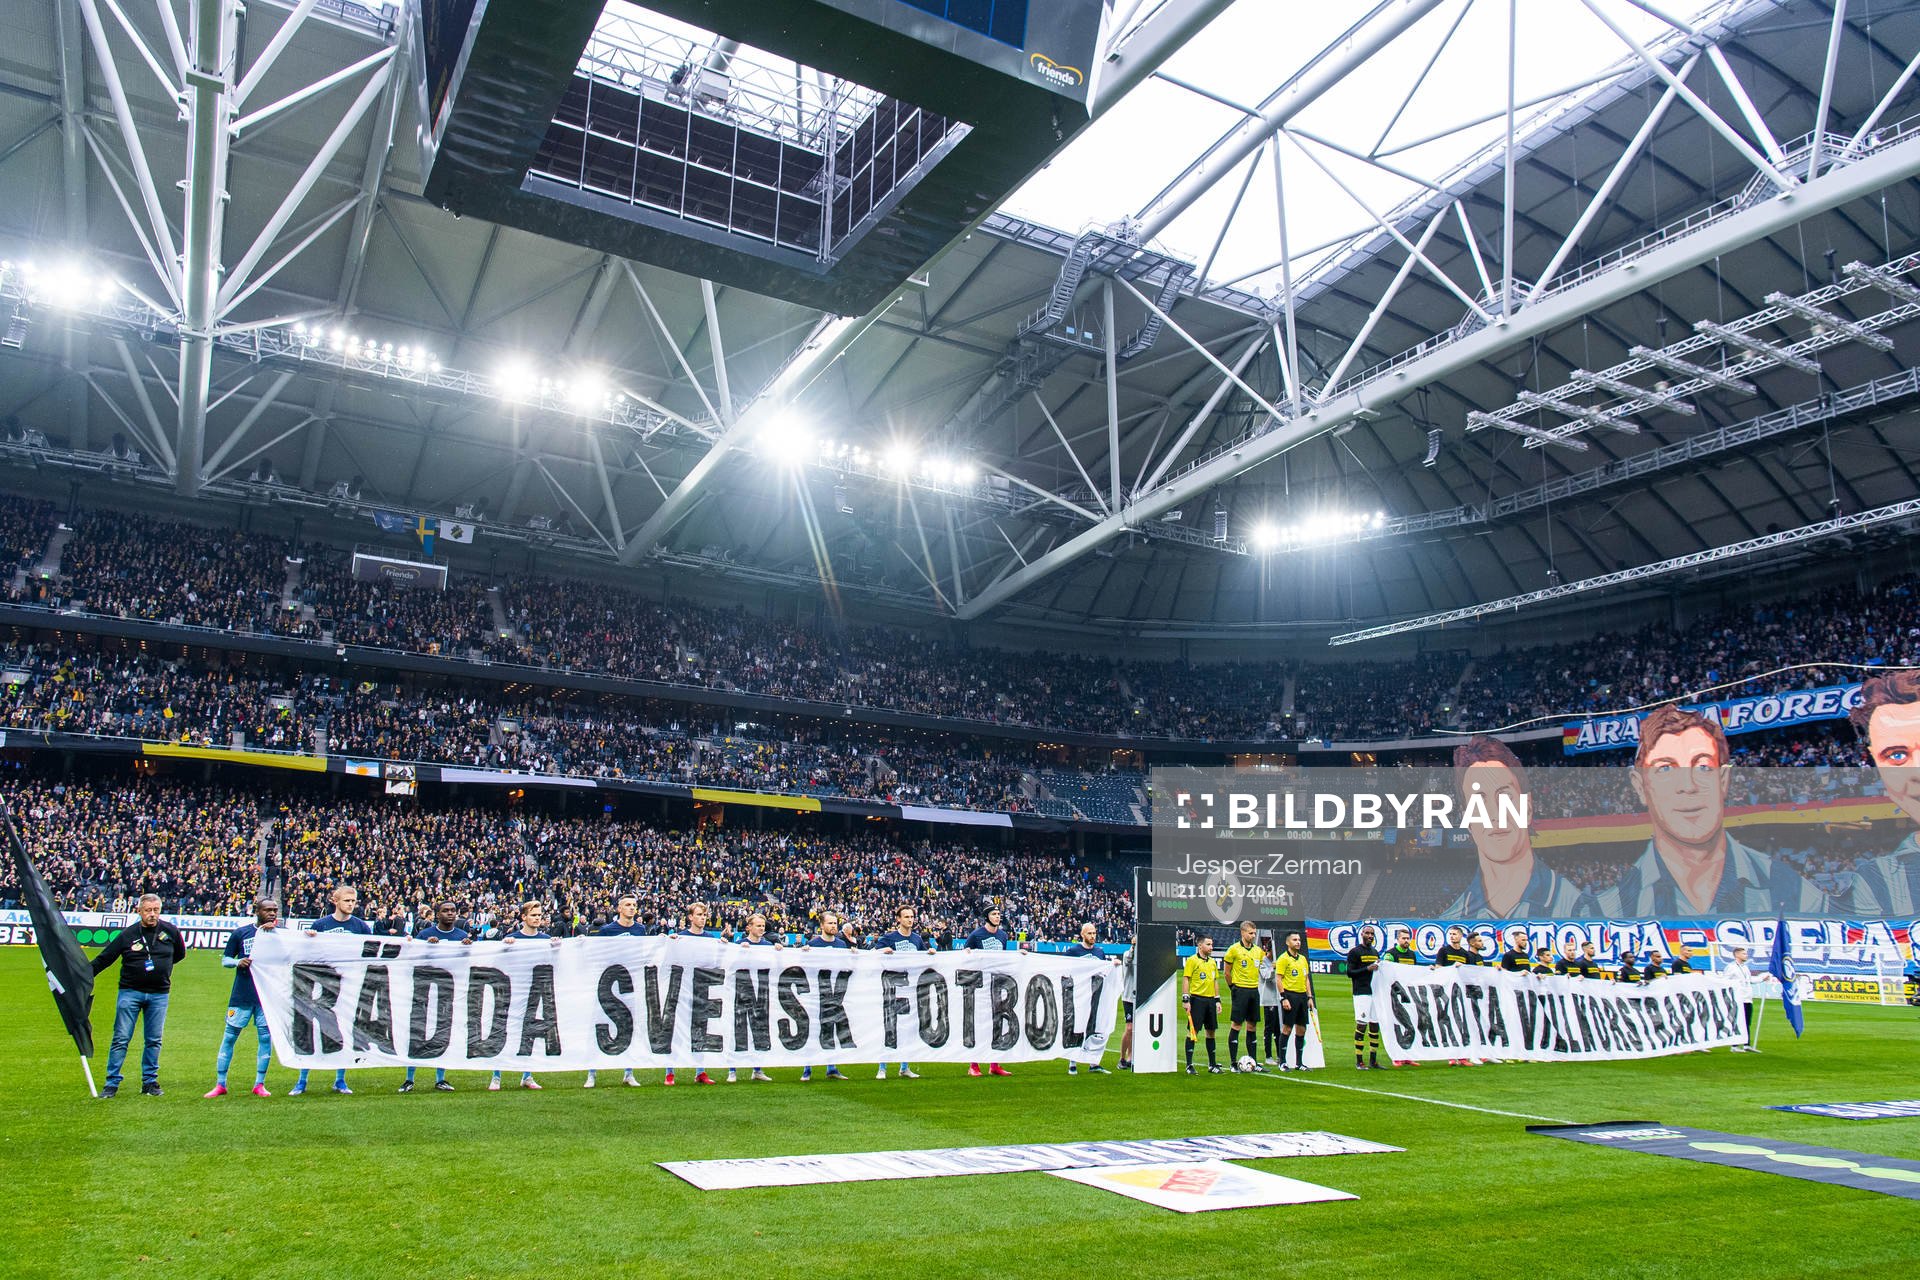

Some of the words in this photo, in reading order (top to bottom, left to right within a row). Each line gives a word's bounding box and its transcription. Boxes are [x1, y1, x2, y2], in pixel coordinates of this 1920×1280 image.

[1037, 61, 1075, 86] friends
[1576, 716, 1640, 748] ÄRA
[291, 940, 562, 1060] RÄDDA
[595, 964, 858, 1056] SVENSK
